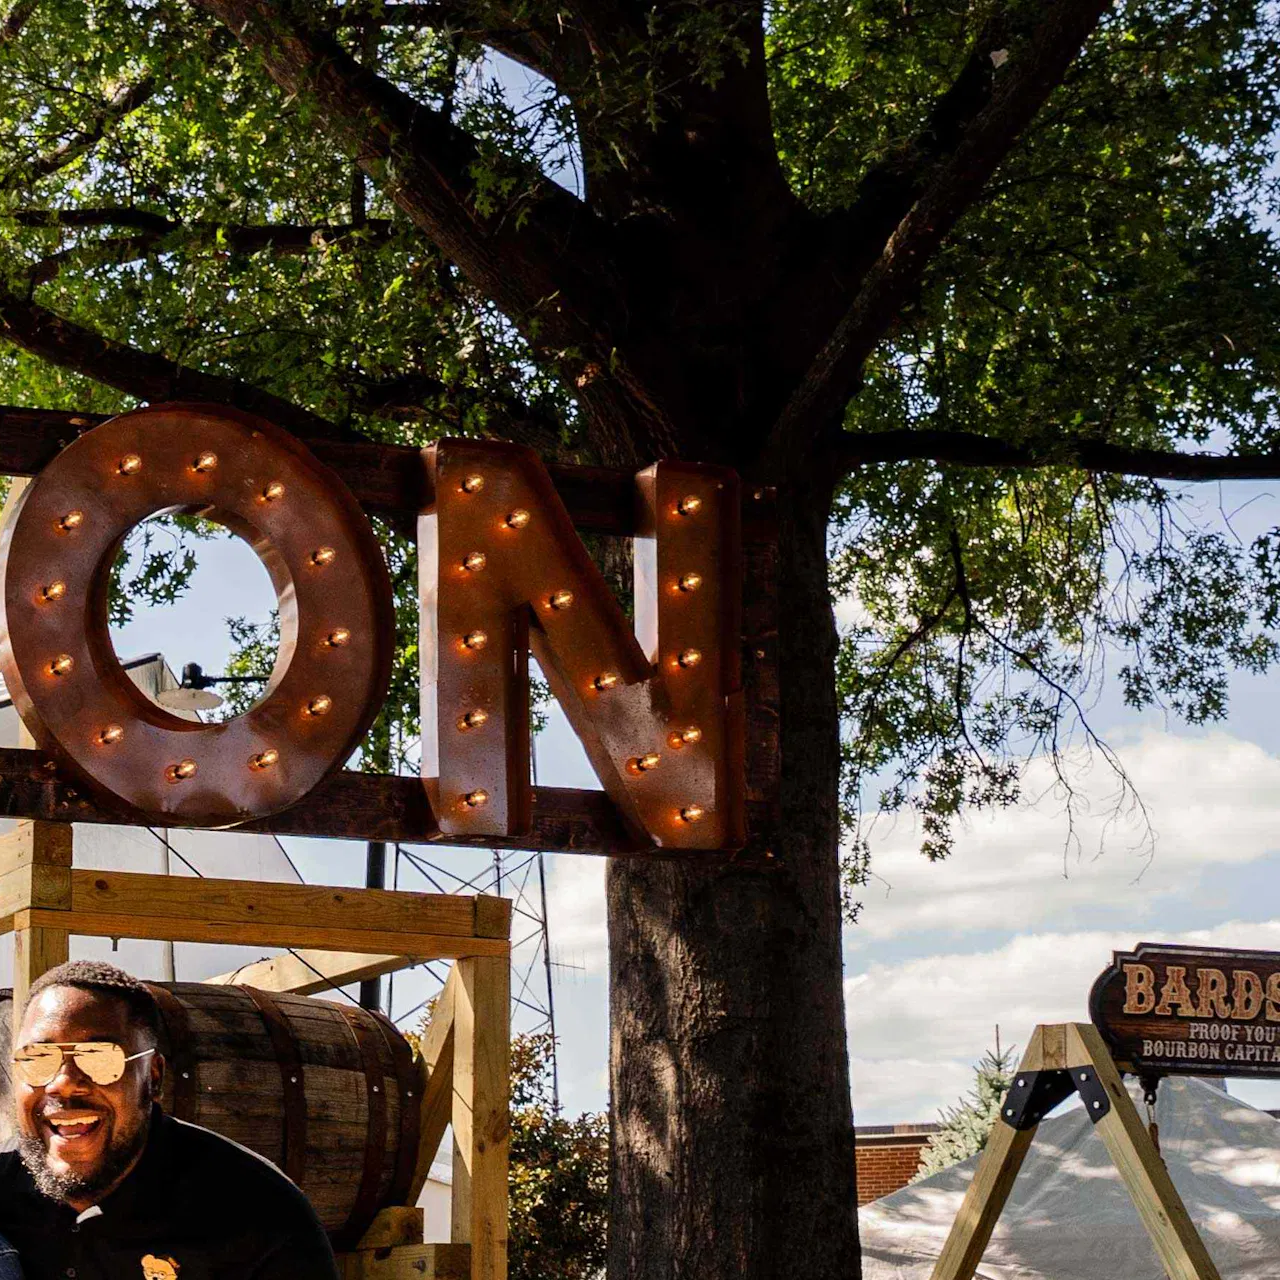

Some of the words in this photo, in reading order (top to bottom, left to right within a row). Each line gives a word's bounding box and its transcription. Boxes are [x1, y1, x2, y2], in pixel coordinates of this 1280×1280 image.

[1190, 1022, 1241, 1041] PROOF
[1244, 1025, 1280, 1044] YOU
[1142, 1040, 1221, 1060] BOURBON
